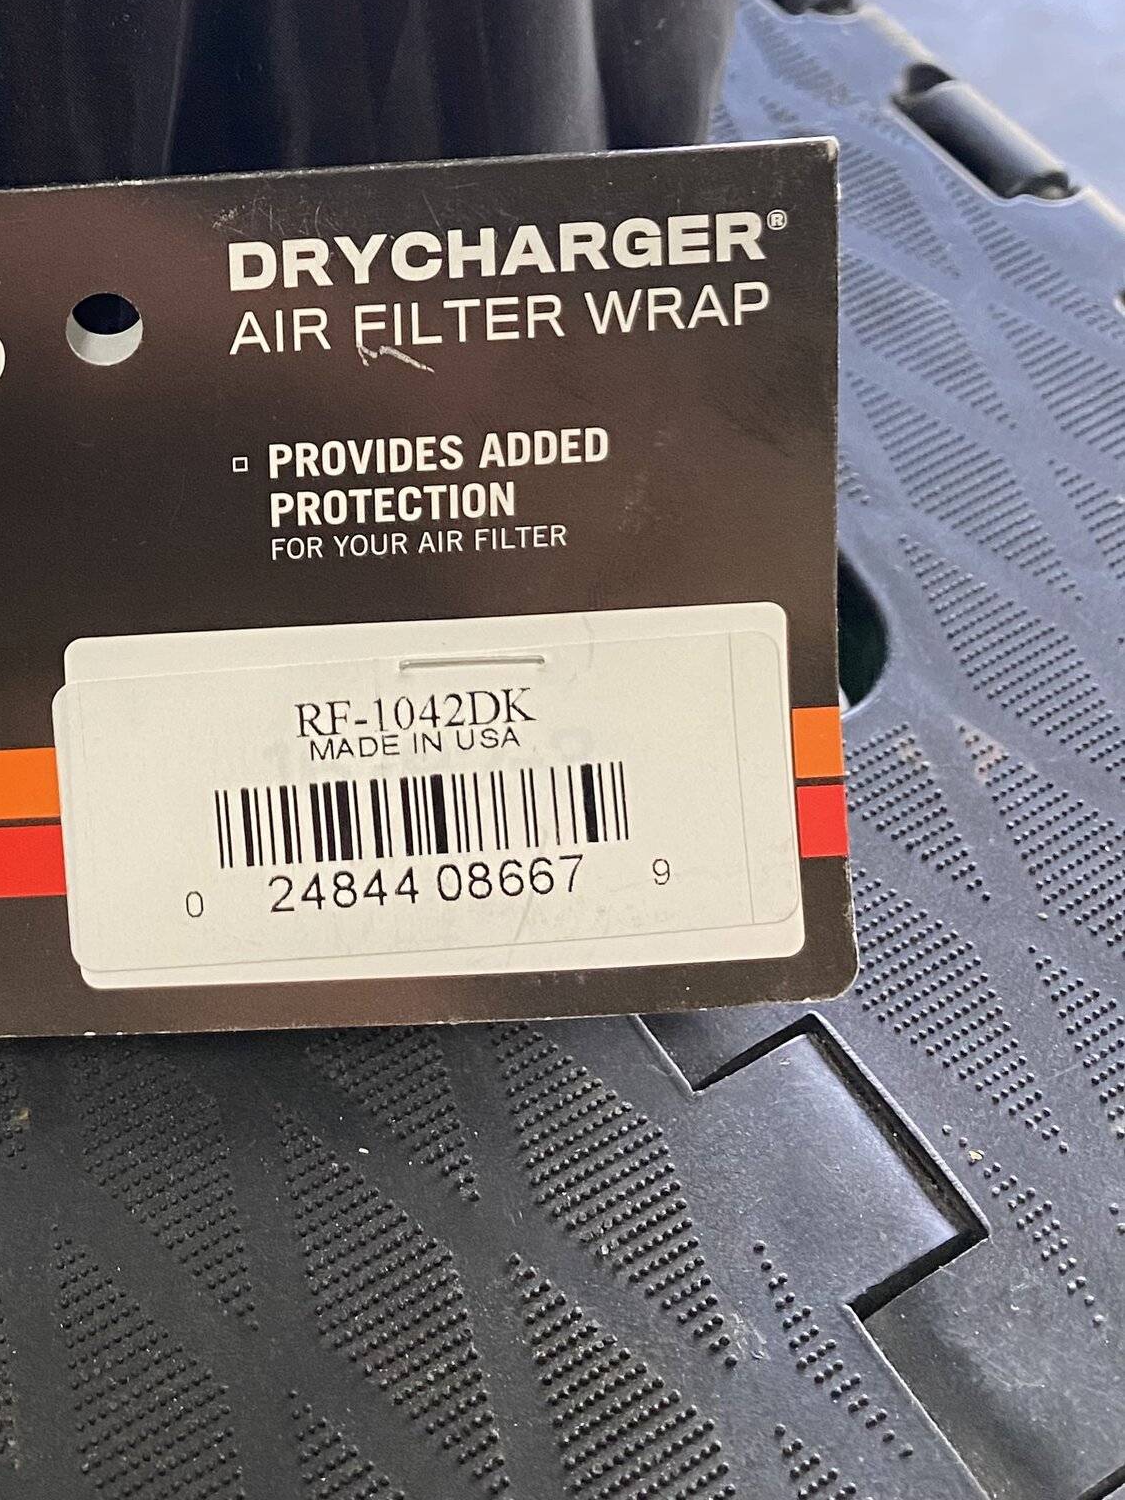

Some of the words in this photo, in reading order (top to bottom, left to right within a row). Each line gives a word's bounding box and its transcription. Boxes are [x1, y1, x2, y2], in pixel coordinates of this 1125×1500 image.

[230, 307, 331, 355] AIR
[353, 294, 565, 346] FILTER
[584, 281, 769, 334] WRAP
[268, 435, 463, 479] PROVIDES
[479, 427, 609, 468] ADDED
[270, 481, 515, 527] PROTECTION
[271, 536, 323, 561] FOR
[333, 532, 408, 557] YOUR
[417, 529, 465, 553] AIR
[474, 524, 568, 551] FILTER
[295, 687, 537, 738] RF-1042DK
[309, 734, 401, 762] MADE
[413, 731, 443, 753] IN
[456, 726, 521, 750] USA
[185, 891, 204, 918] 0
[269, 867, 420, 913] 24844
[437, 854, 584, 902] 08667
[652, 858, 671, 886] 9
